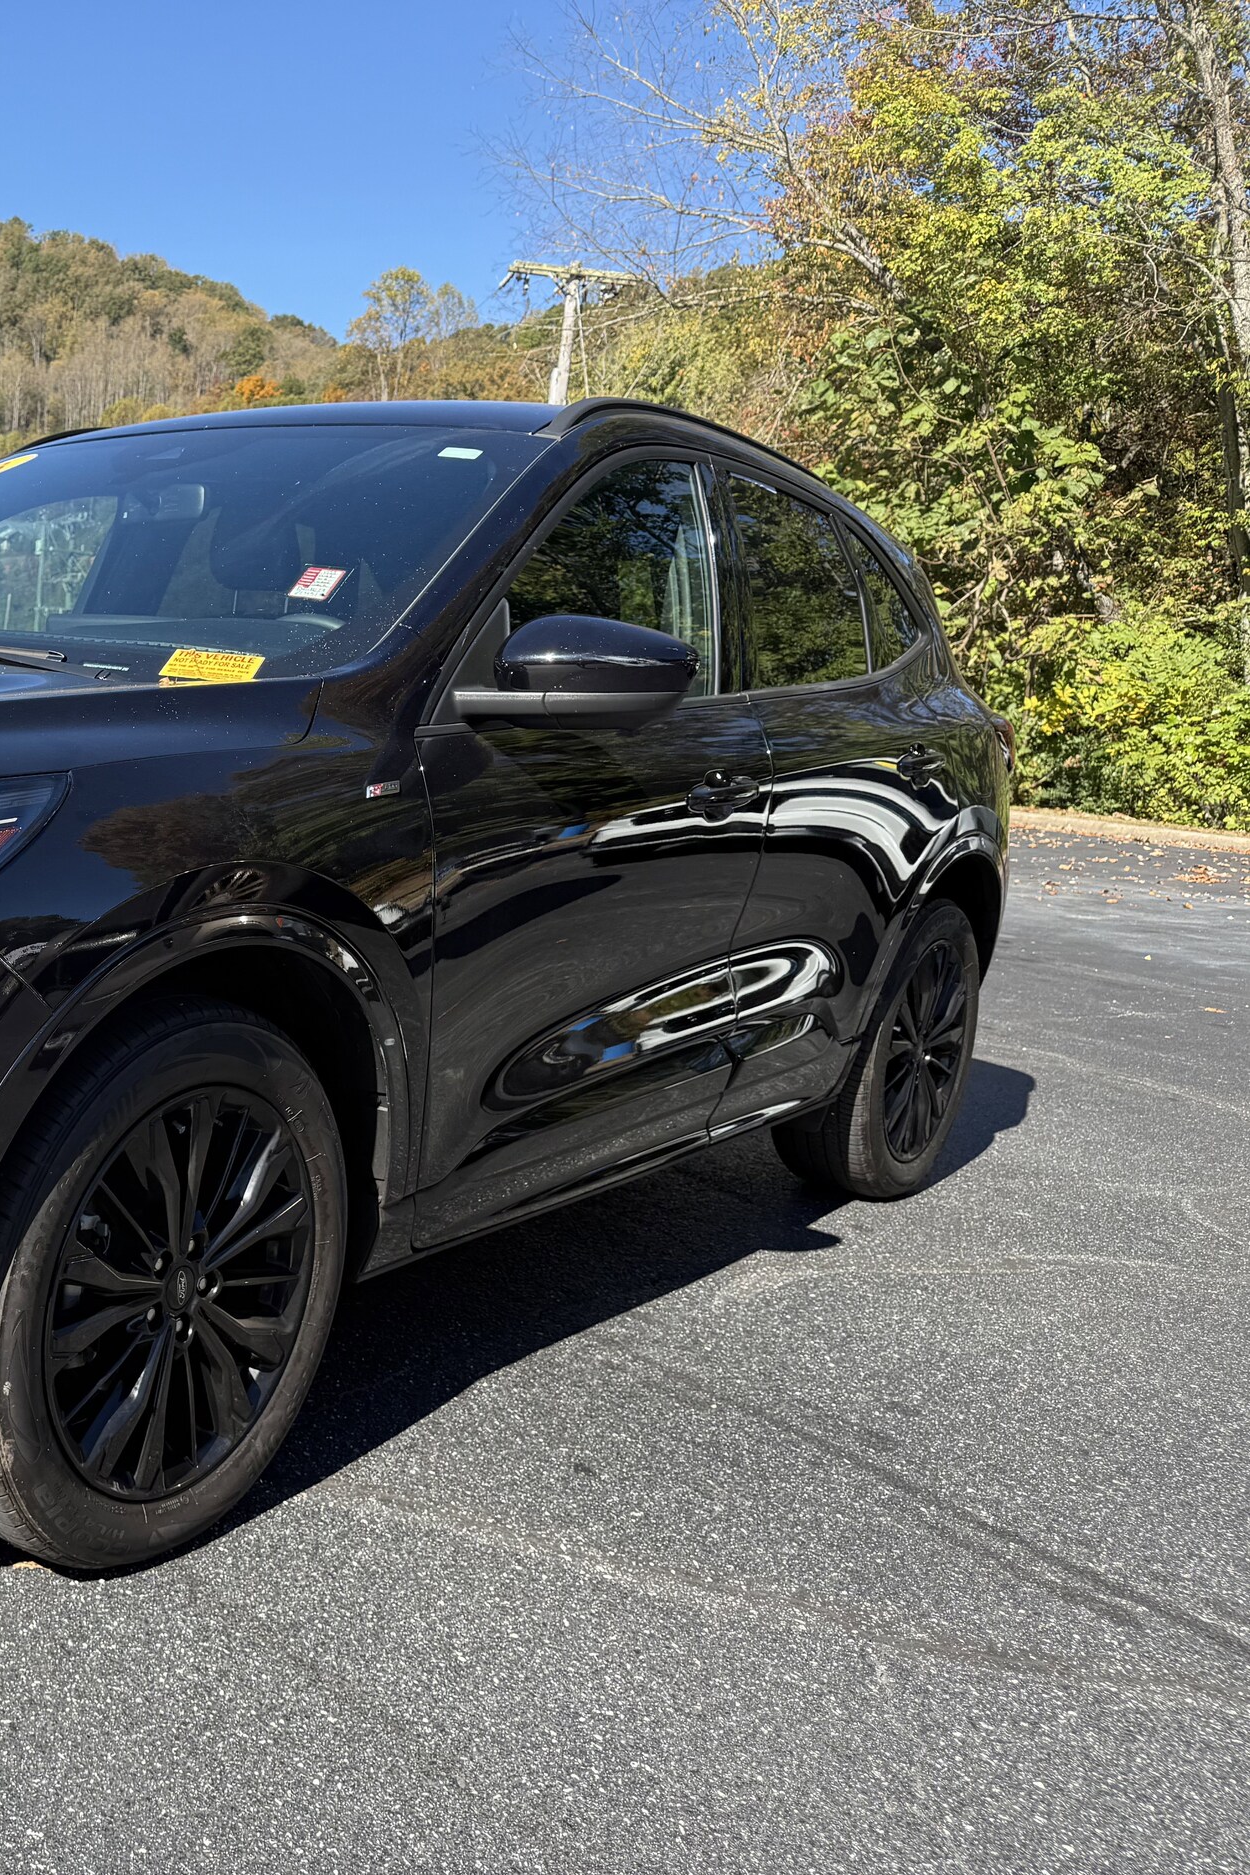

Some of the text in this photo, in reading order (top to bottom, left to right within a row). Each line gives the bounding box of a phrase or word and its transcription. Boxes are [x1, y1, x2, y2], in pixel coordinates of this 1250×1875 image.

[206, 653, 256, 664] VEHICLE
[213, 660, 230, 668] FOR
[230, 661, 252, 670] SALE
